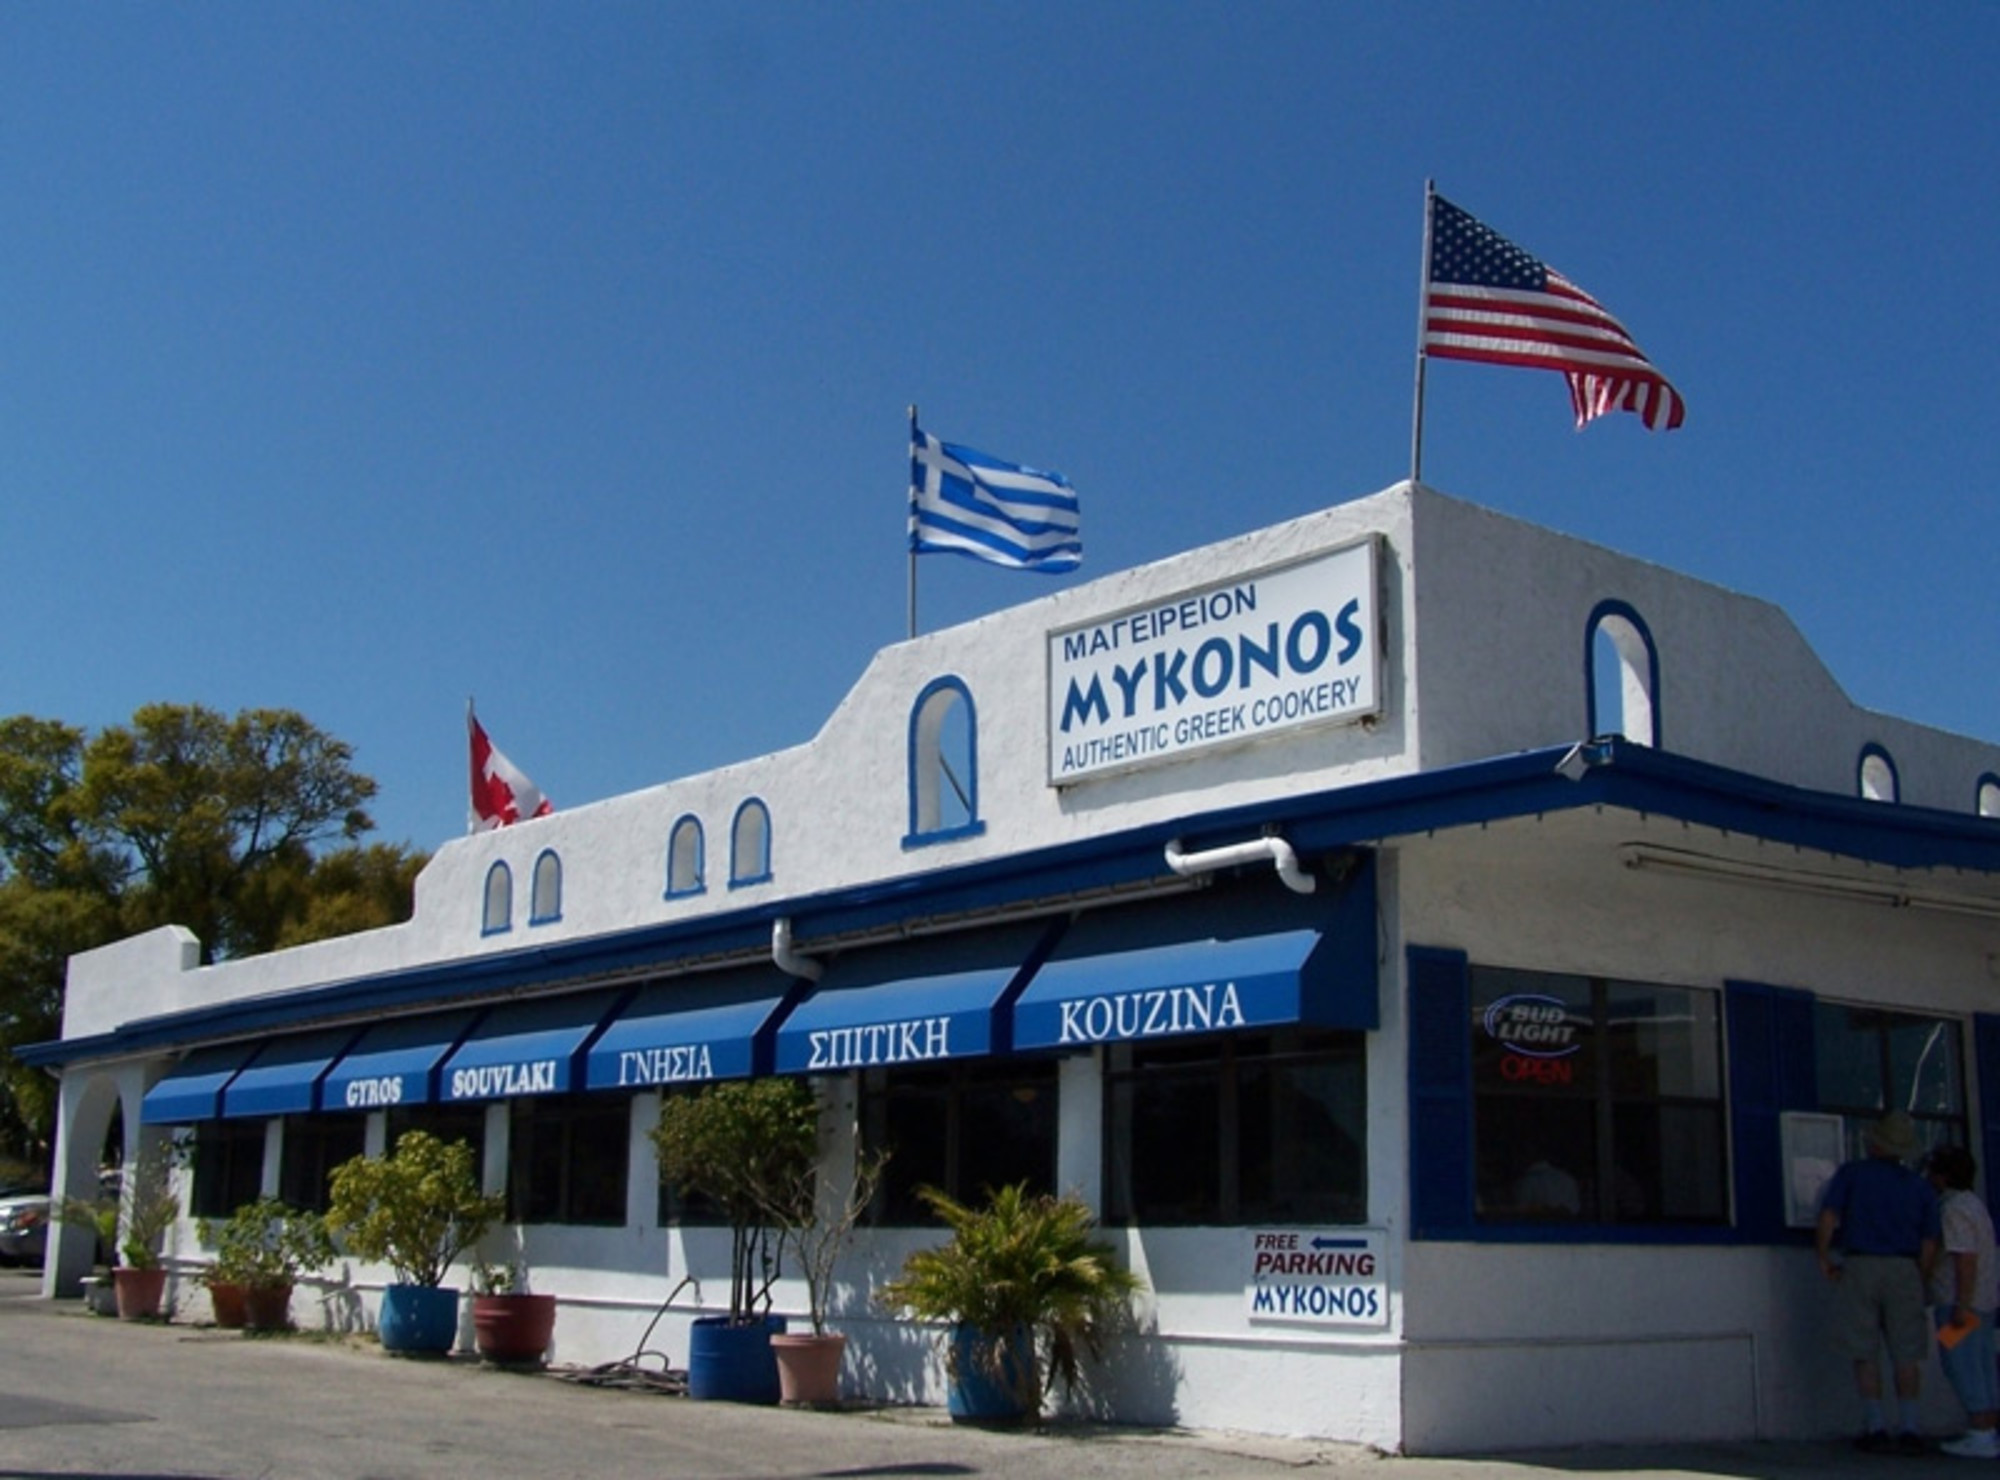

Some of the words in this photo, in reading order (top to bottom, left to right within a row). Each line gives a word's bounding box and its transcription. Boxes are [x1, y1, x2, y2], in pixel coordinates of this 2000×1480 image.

[1063, 584, 1257, 662] ΜΑΓΕΙΡΕΙΟΝ
[1059, 597, 1363, 733] MYKONOS
[1062, 722, 1169, 772] AUTHENTIC
[1174, 704, 1246, 745] GREEK
[1251, 675, 1361, 726] COOKERY
[1511, 1005, 1566, 1024] BUD
[808, 1017, 951, 1069] ΣΠΙΤΙΚΗ
[1499, 1022, 1575, 1044] LIGHT
[452, 1061, 557, 1098] SOUVLAKI
[619, 1044, 713, 1086] ΓΝΗΣΙΑ
[1500, 1055, 1573, 1085] OPEN
[346, 1076, 402, 1107] GYROS
[1255, 1234, 1299, 1250] FREE
[1255, 1252, 1376, 1277] PARKING
[1253, 1284, 1378, 1317] MYKONOS
